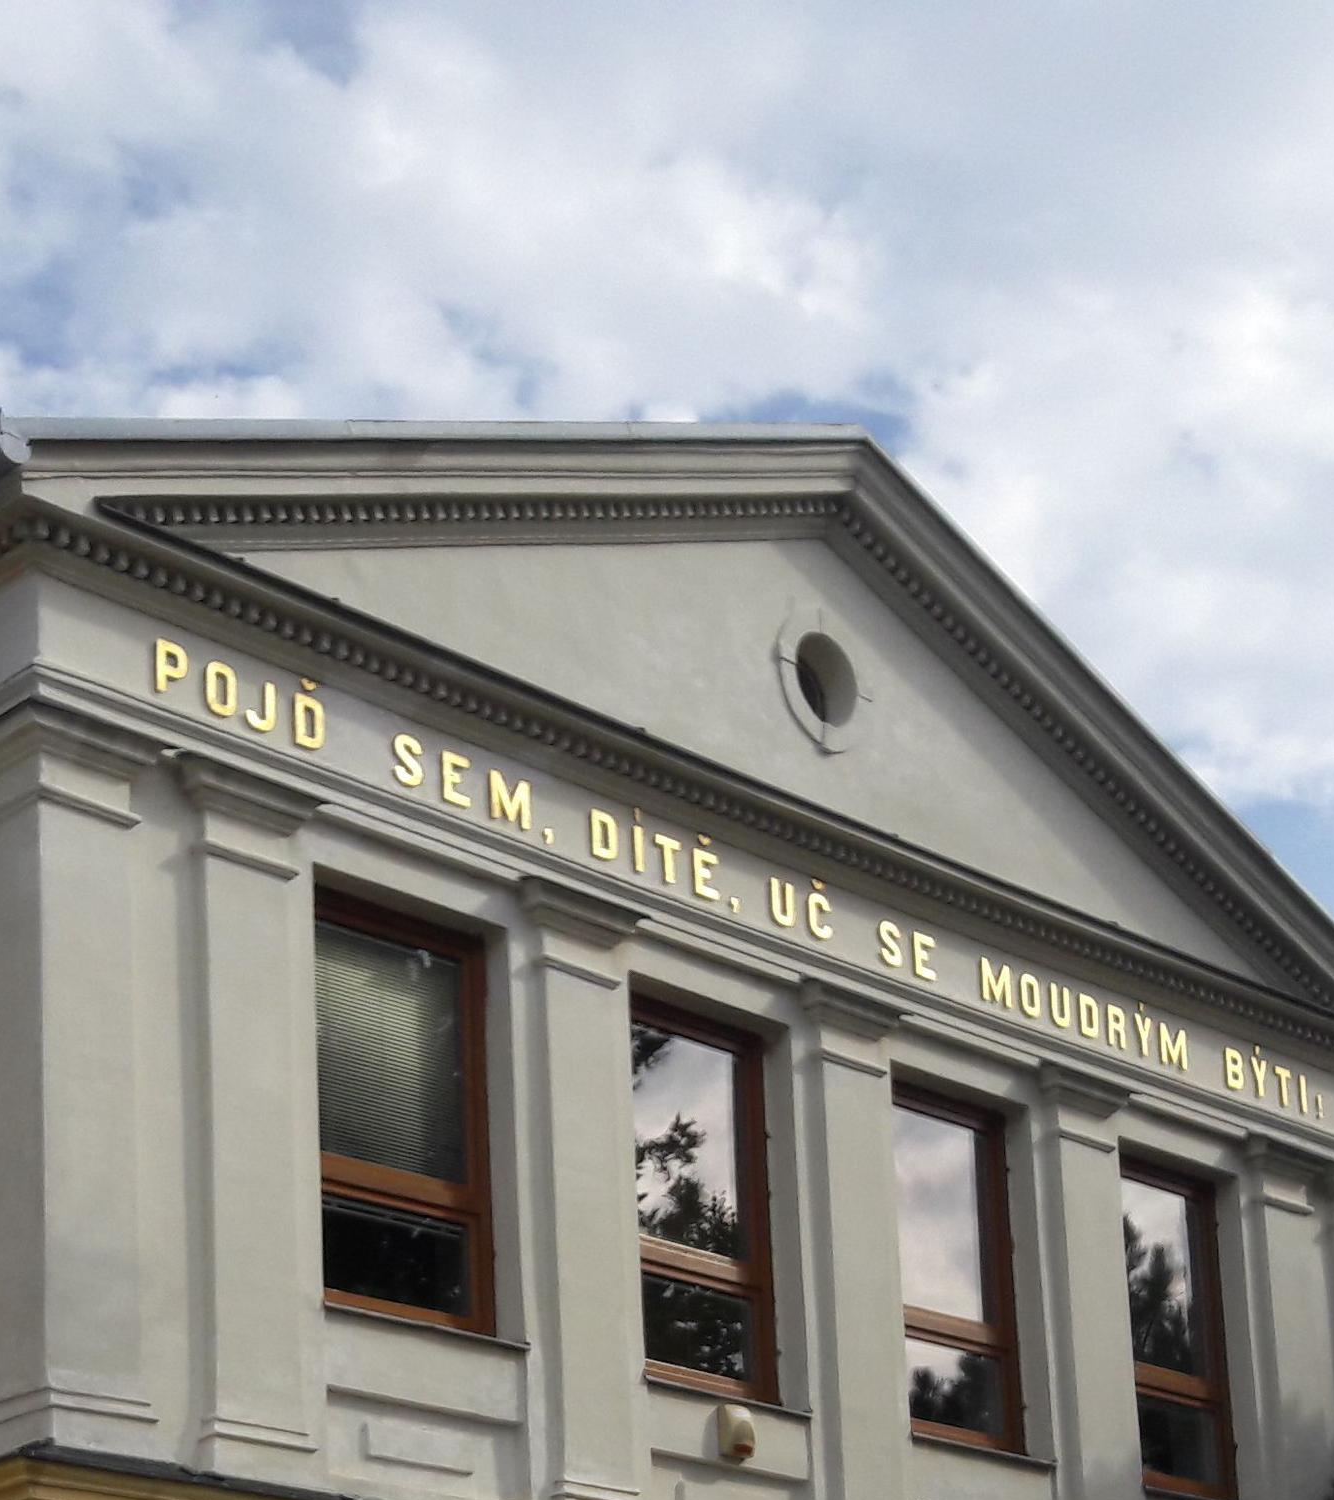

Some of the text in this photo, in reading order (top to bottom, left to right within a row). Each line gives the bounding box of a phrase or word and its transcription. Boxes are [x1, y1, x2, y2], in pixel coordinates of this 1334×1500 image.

[154, 637, 1325, 1119] POJĎ SEM, DÍTĚ, UČ SE MOUDRÝM BÝTI!
